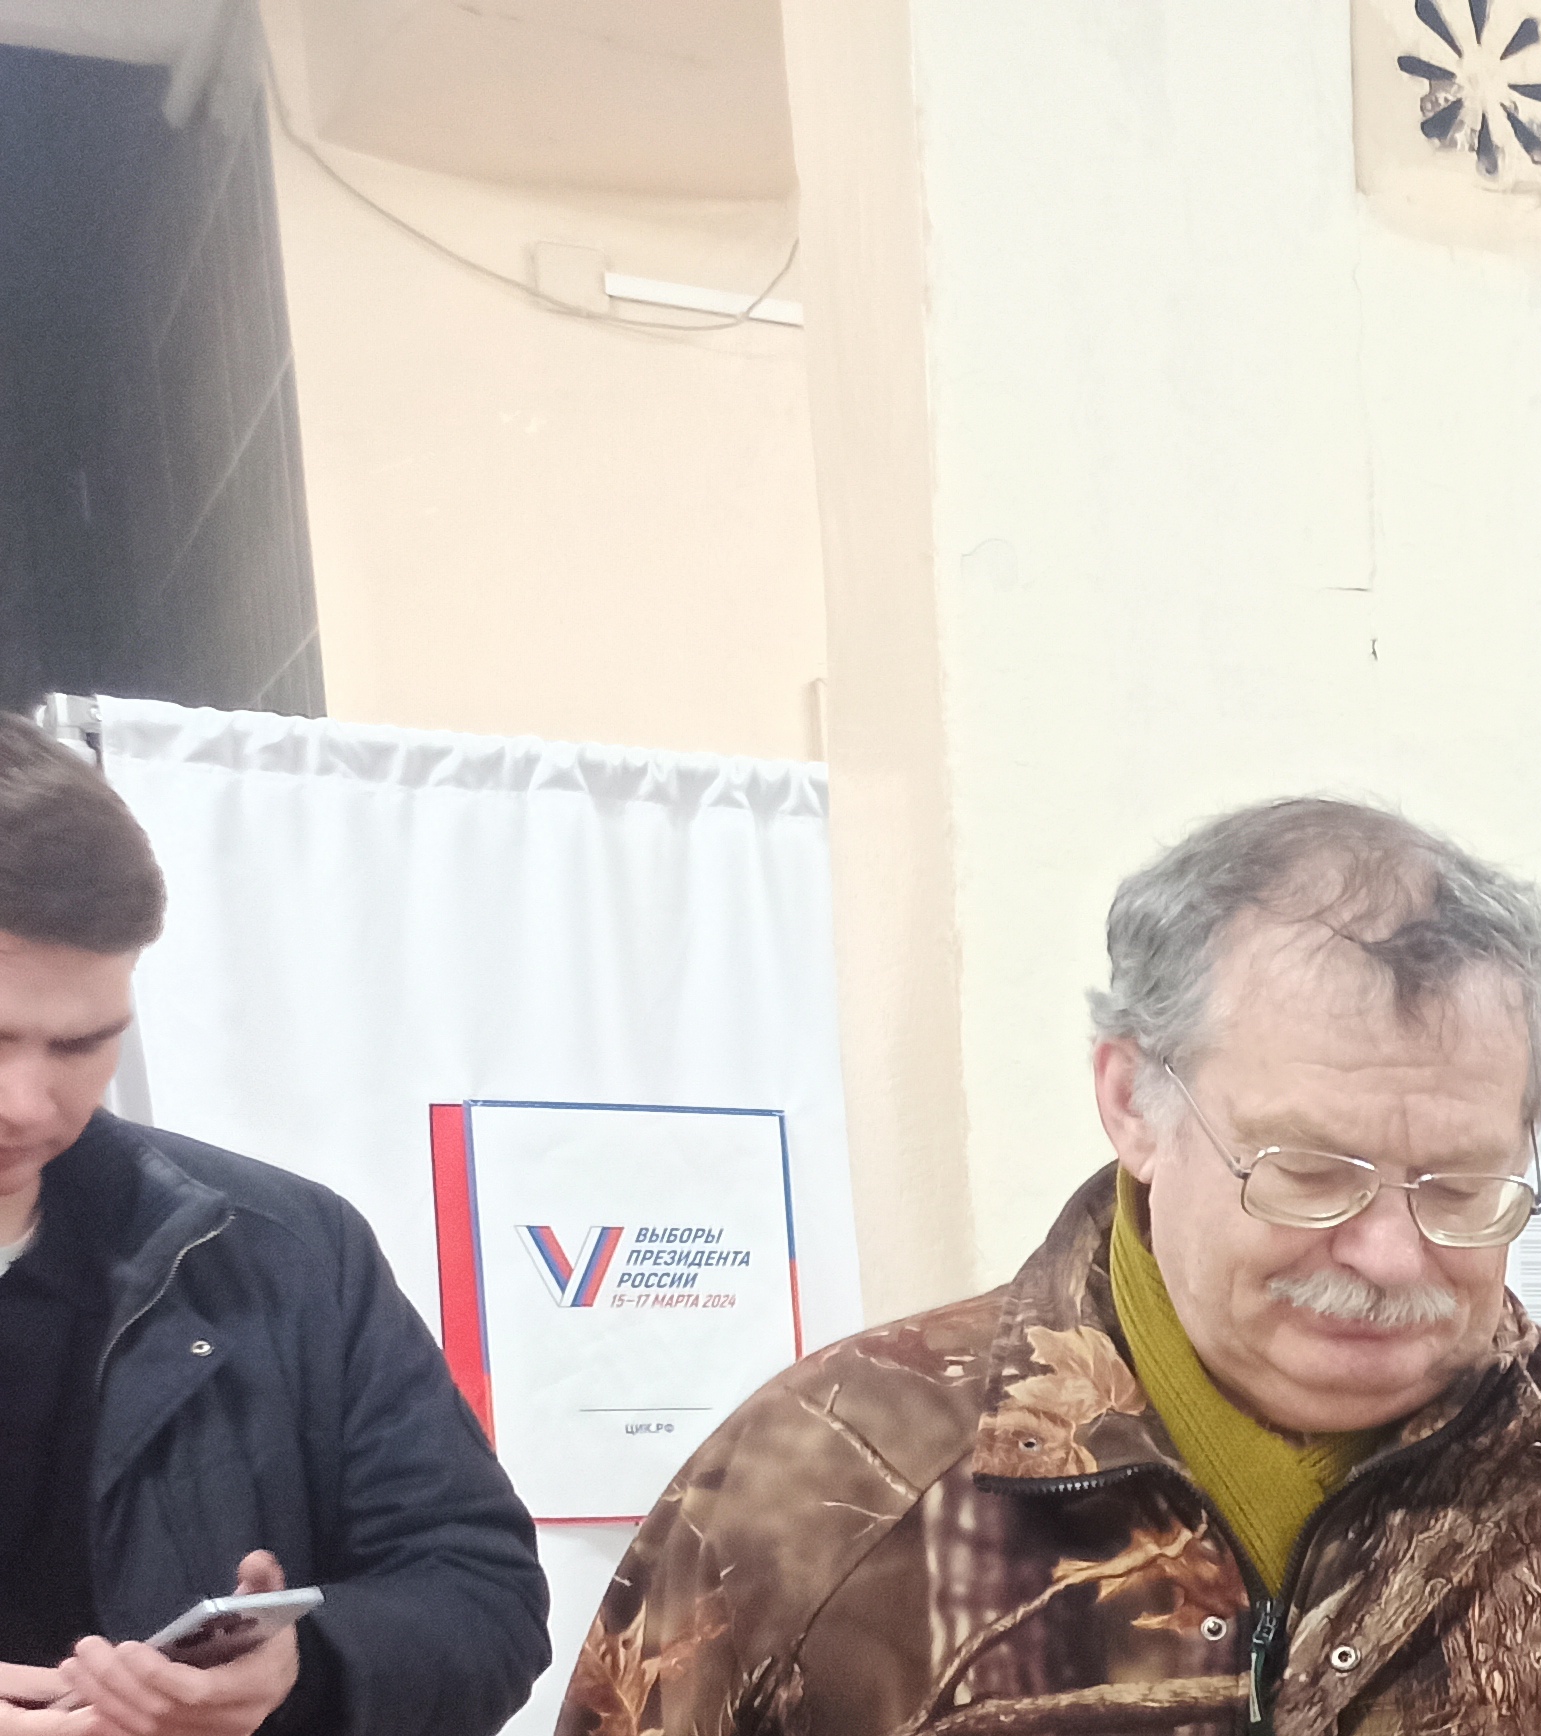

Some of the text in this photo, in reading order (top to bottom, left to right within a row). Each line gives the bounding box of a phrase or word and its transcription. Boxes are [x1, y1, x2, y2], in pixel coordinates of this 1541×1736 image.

[634, 1226, 725, 1245] ВЫБОРЫ
[626, 1249, 751, 1269] ПРЕЗИДЕНТА
[616, 1272, 699, 1289] РОССИИ
[650, 1293, 701, 1309] МАРТА
[701, 1293, 737, 1309] 2024
